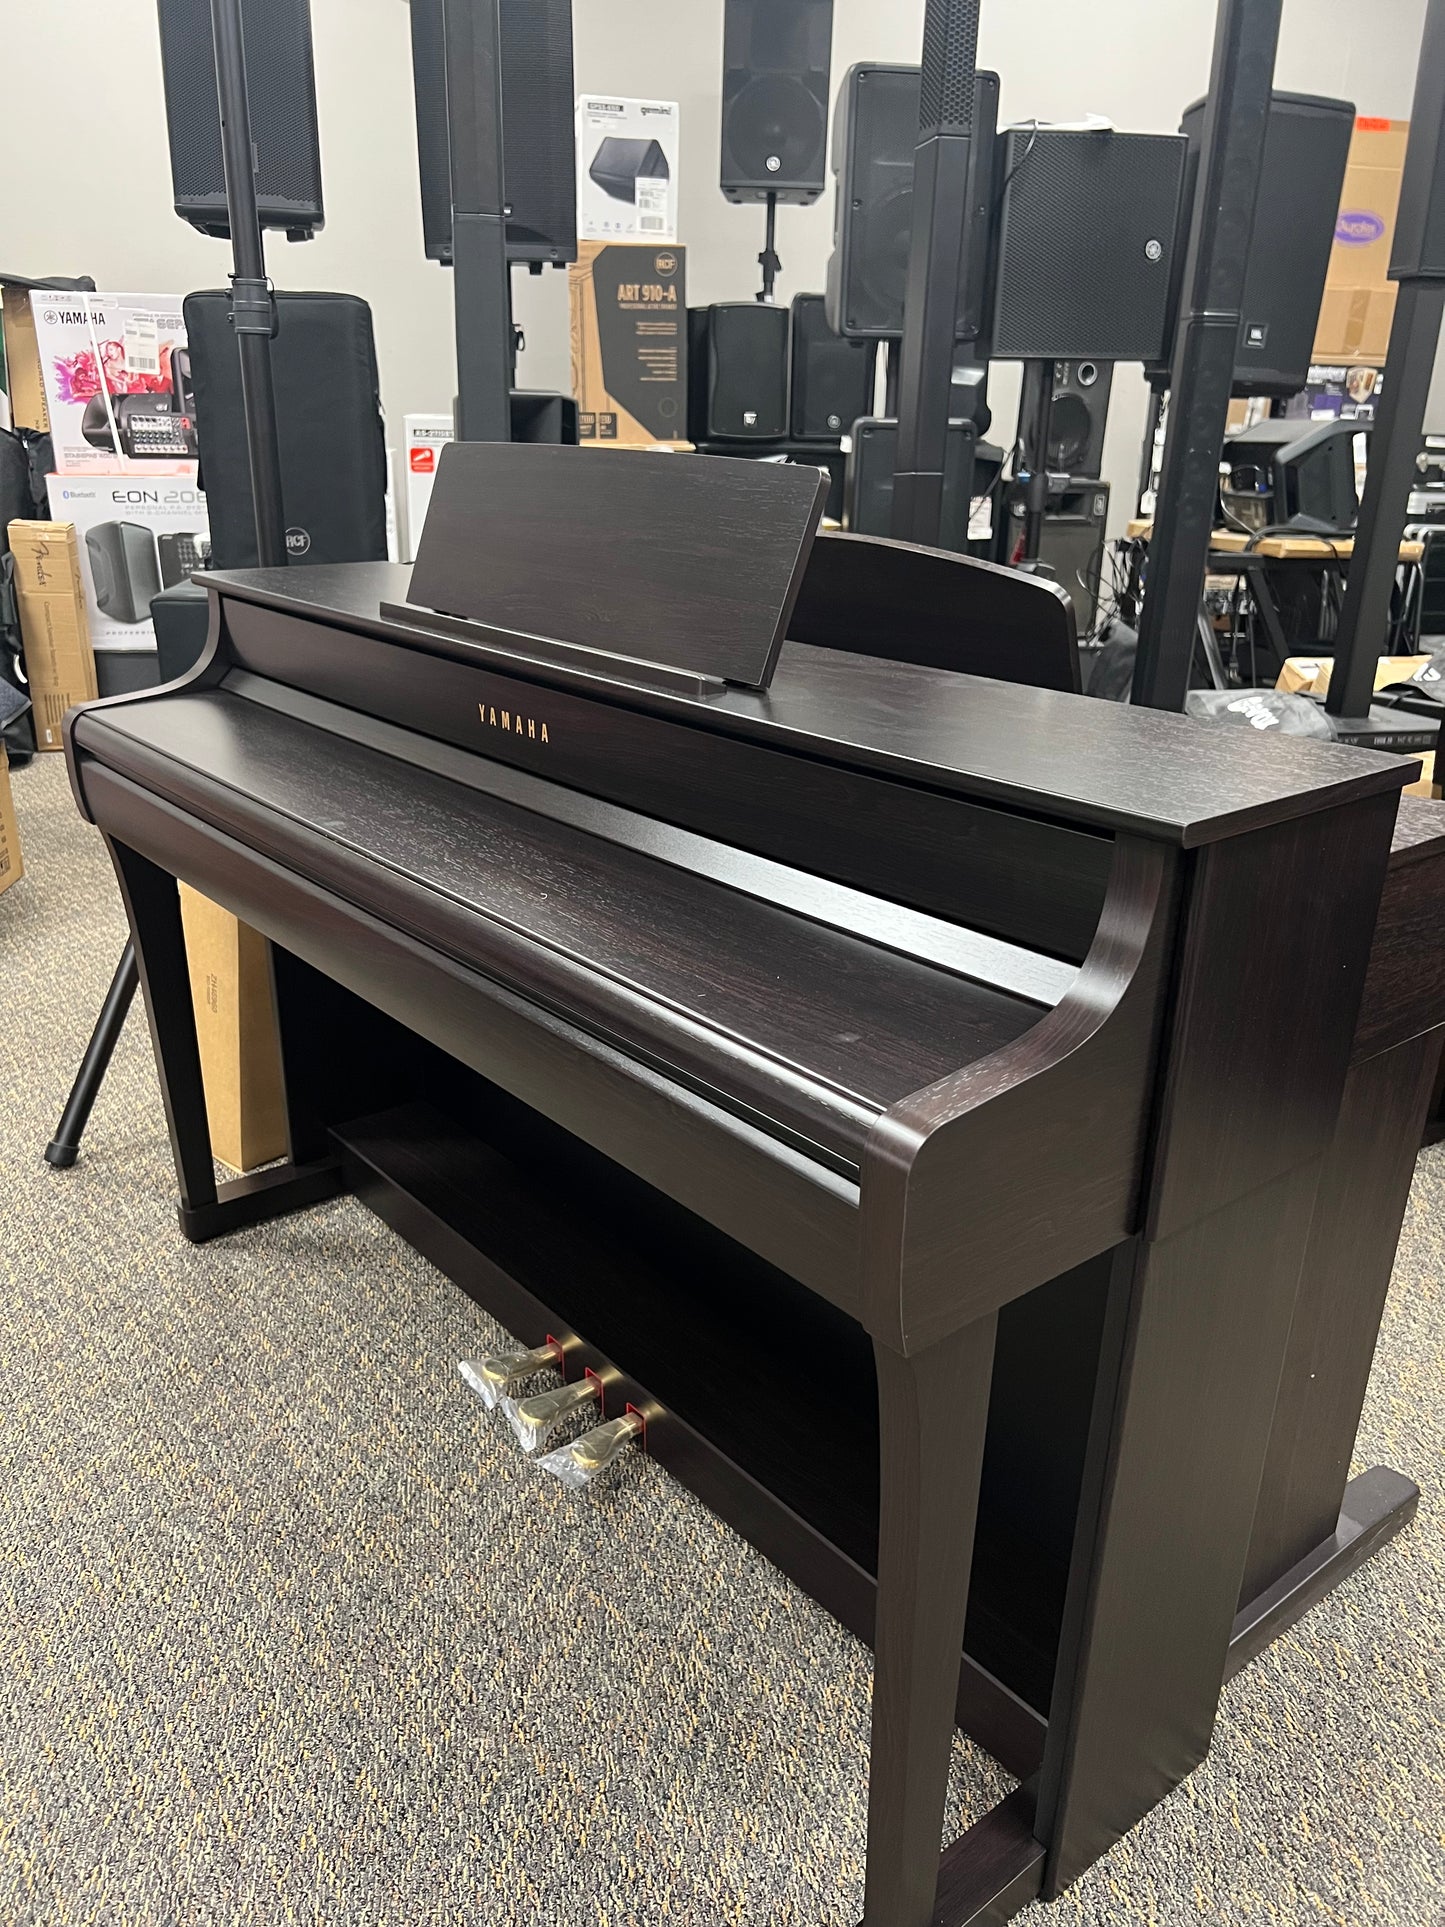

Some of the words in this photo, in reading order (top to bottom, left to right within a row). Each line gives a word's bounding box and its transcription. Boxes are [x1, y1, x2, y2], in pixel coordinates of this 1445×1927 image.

[656, 259, 676, 269] RCF
[618, 284, 640, 301] ART
[642, 284, 677, 302] 910-A
[58, 311, 106, 325] YAMAHA
[112, 491, 158, 503] EON
[286, 535, 307, 547] RCF
[478, 703, 549, 743] YAMAHA
